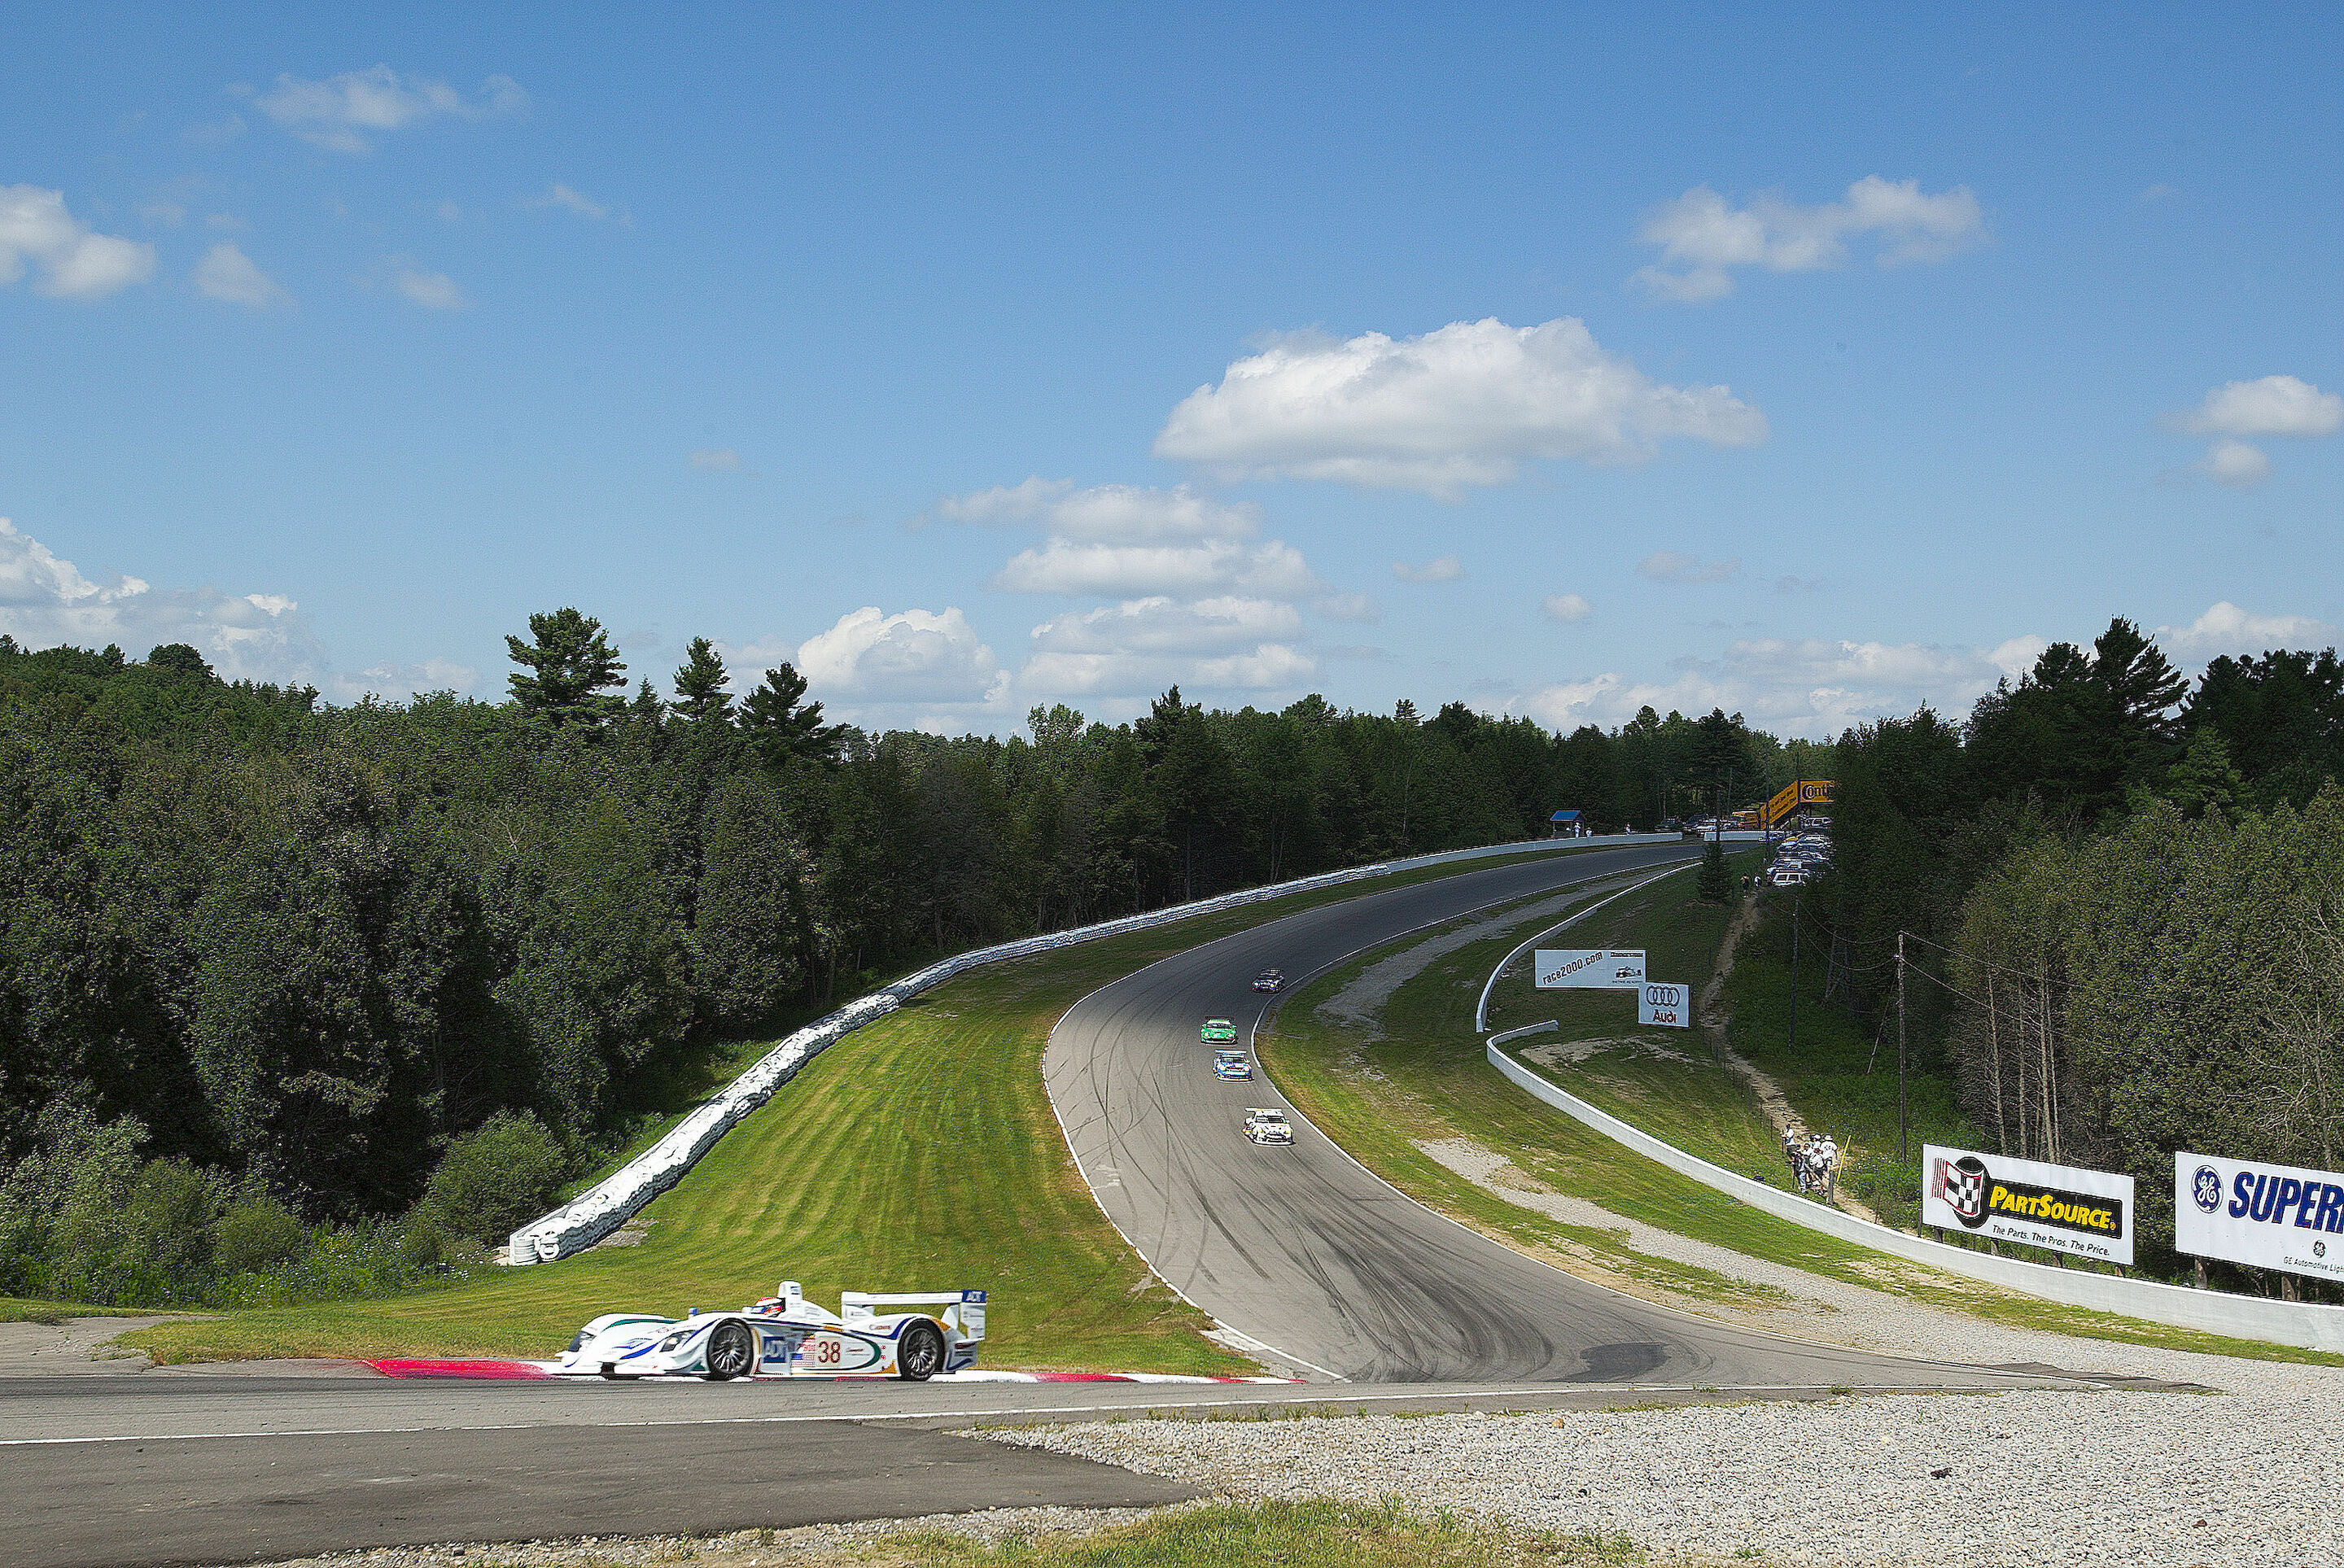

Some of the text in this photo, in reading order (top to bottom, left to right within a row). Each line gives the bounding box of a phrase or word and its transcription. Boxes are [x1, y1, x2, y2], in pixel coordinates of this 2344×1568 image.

[1542, 951, 1603, 985] race2000.com
[1653, 1009, 1677, 1023] Audi
[2228, 1172, 2344, 1234] SUPER
[1993, 1225, 2005, 1234] The
[2007, 1229, 2029, 1240] Parts.
[2032, 1232, 2047, 1243] The
[2071, 1240, 2084, 1251] The
[2087, 1243, 2110, 1256] Price.
[818, 1341, 841, 1363] 38
